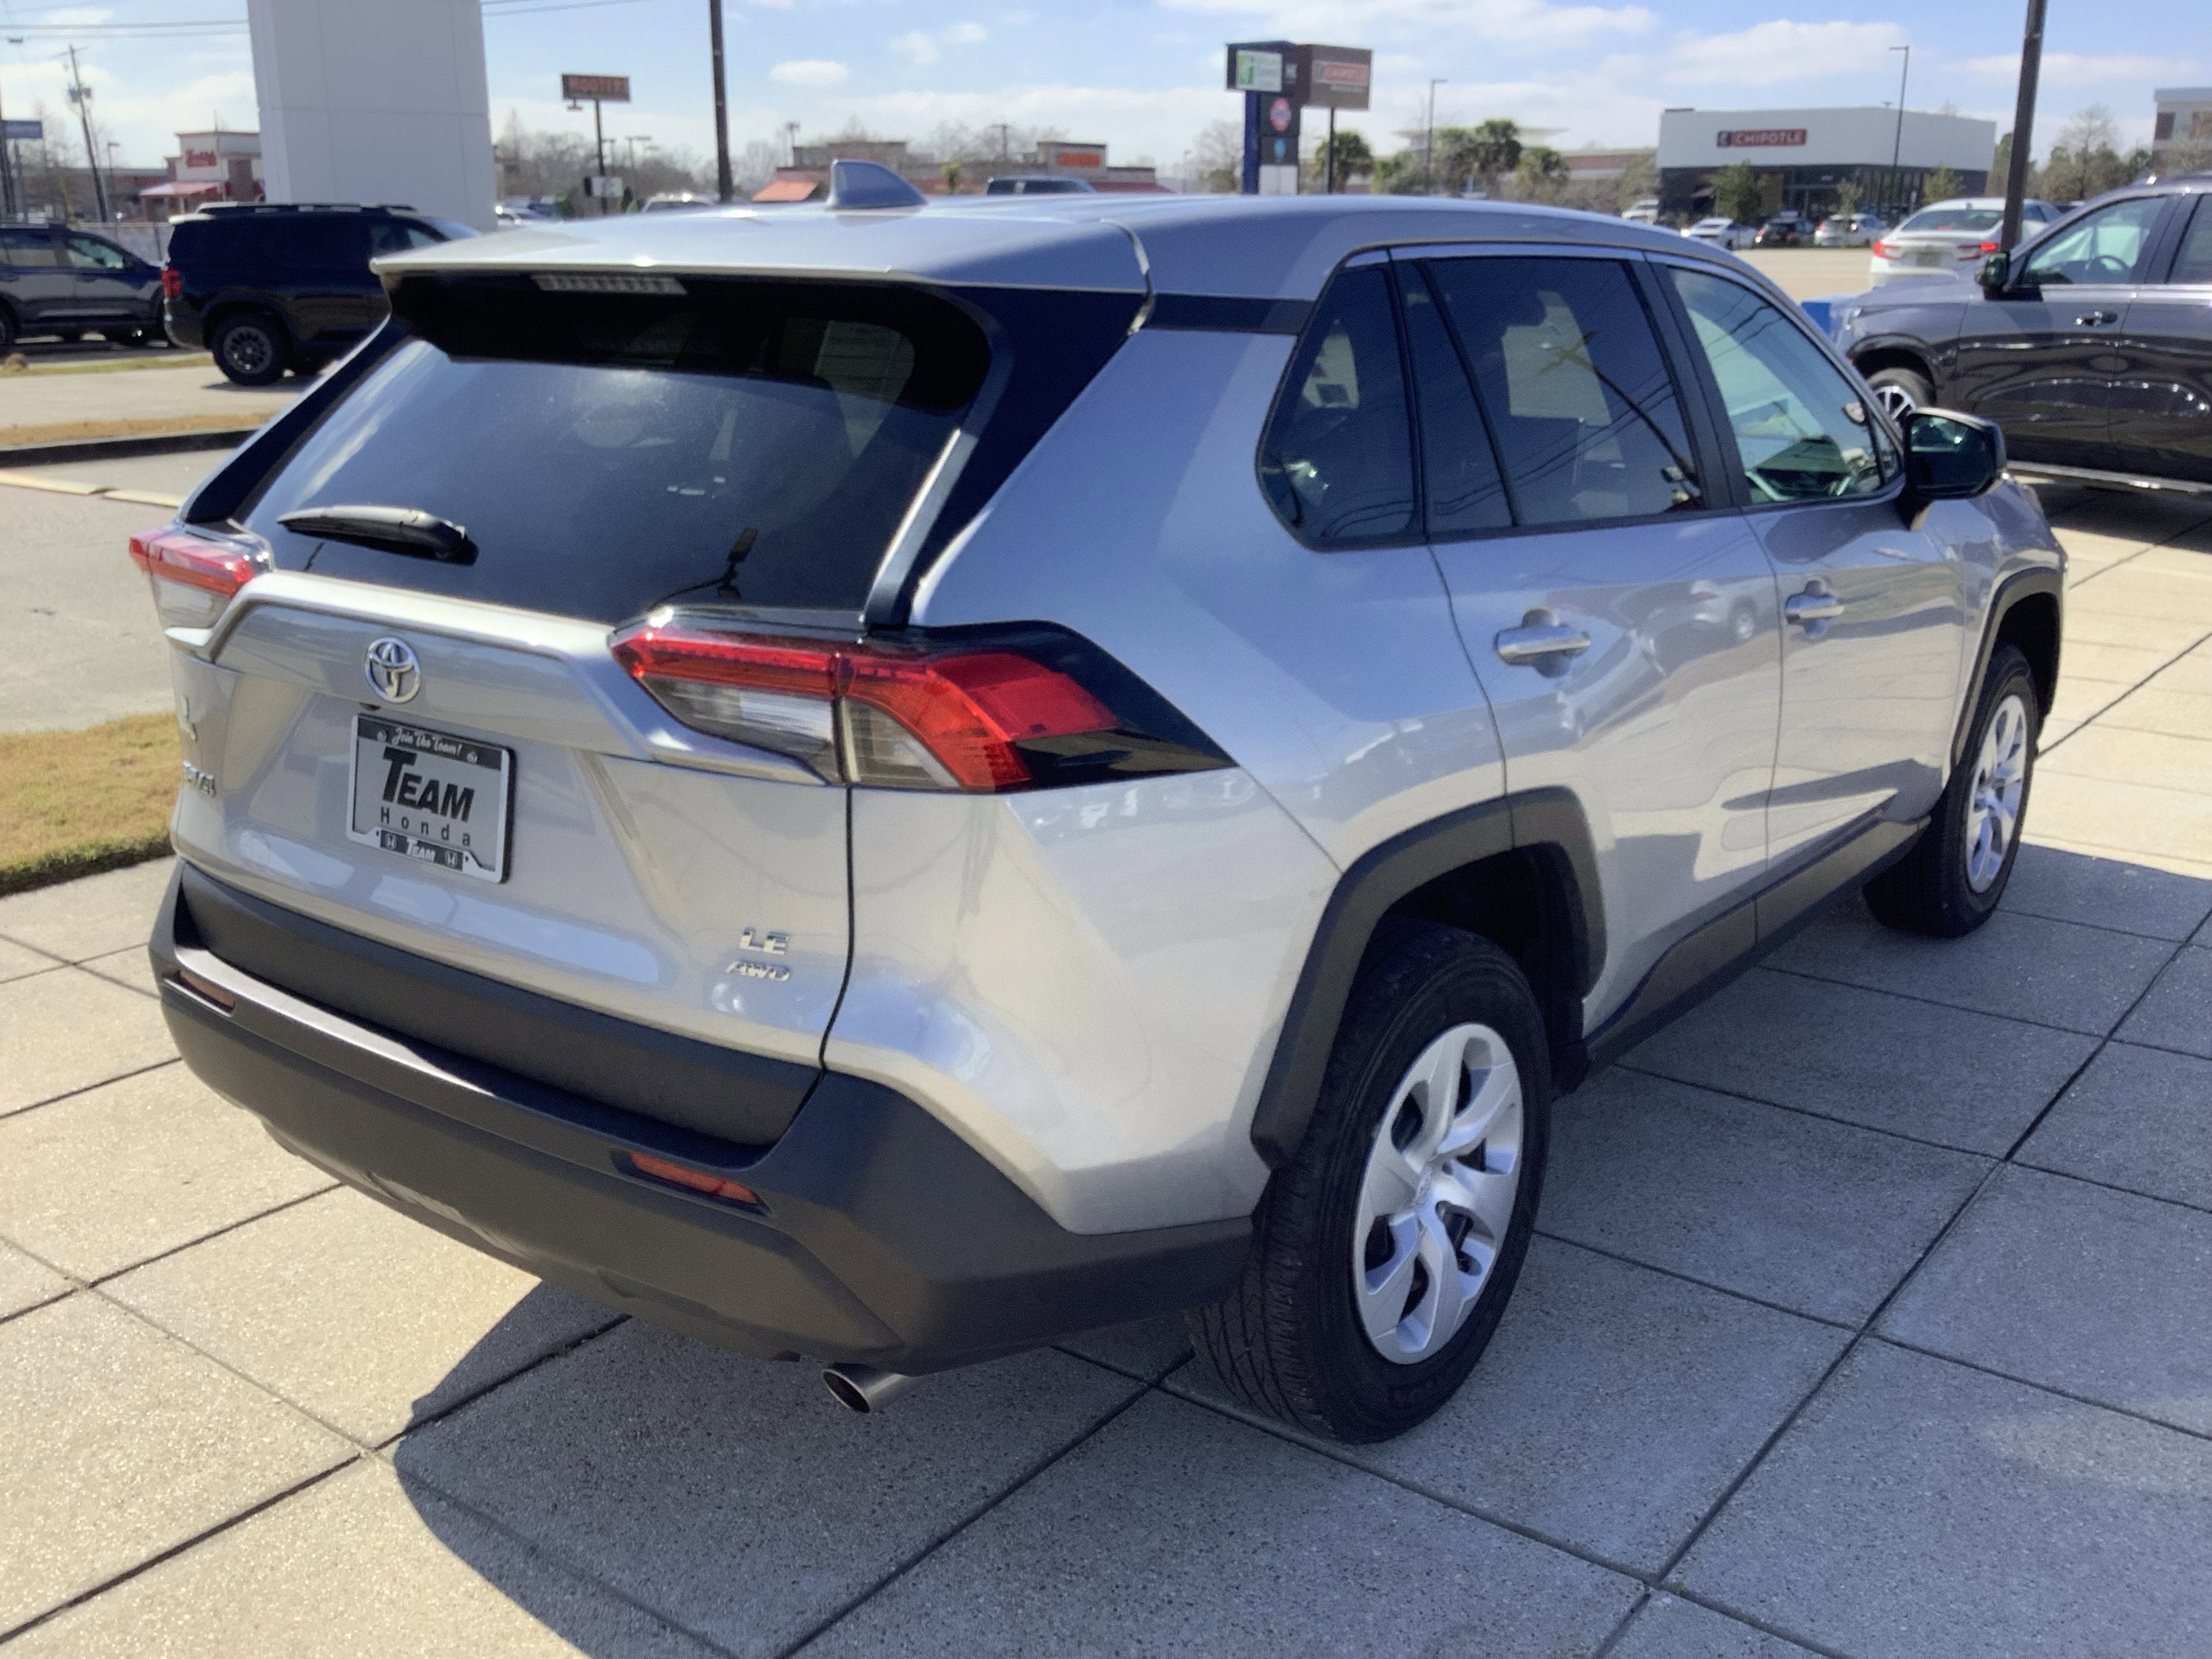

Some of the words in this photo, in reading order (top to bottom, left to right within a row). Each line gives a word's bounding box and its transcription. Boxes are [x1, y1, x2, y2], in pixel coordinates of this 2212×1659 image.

[1734, 130, 1804, 145] CHIPOTLE
[392, 726, 413, 746] Join
[414, 732, 431, 749] The
[432, 736, 462, 756] Team!
[182, 760, 216, 797] AV4
[382, 746, 475, 823] TEAM
[381, 806, 471, 846] Honda
[407, 836, 436, 863] TEAM
[739, 927, 789, 955] LE
[726, 959, 790, 981] AWD
